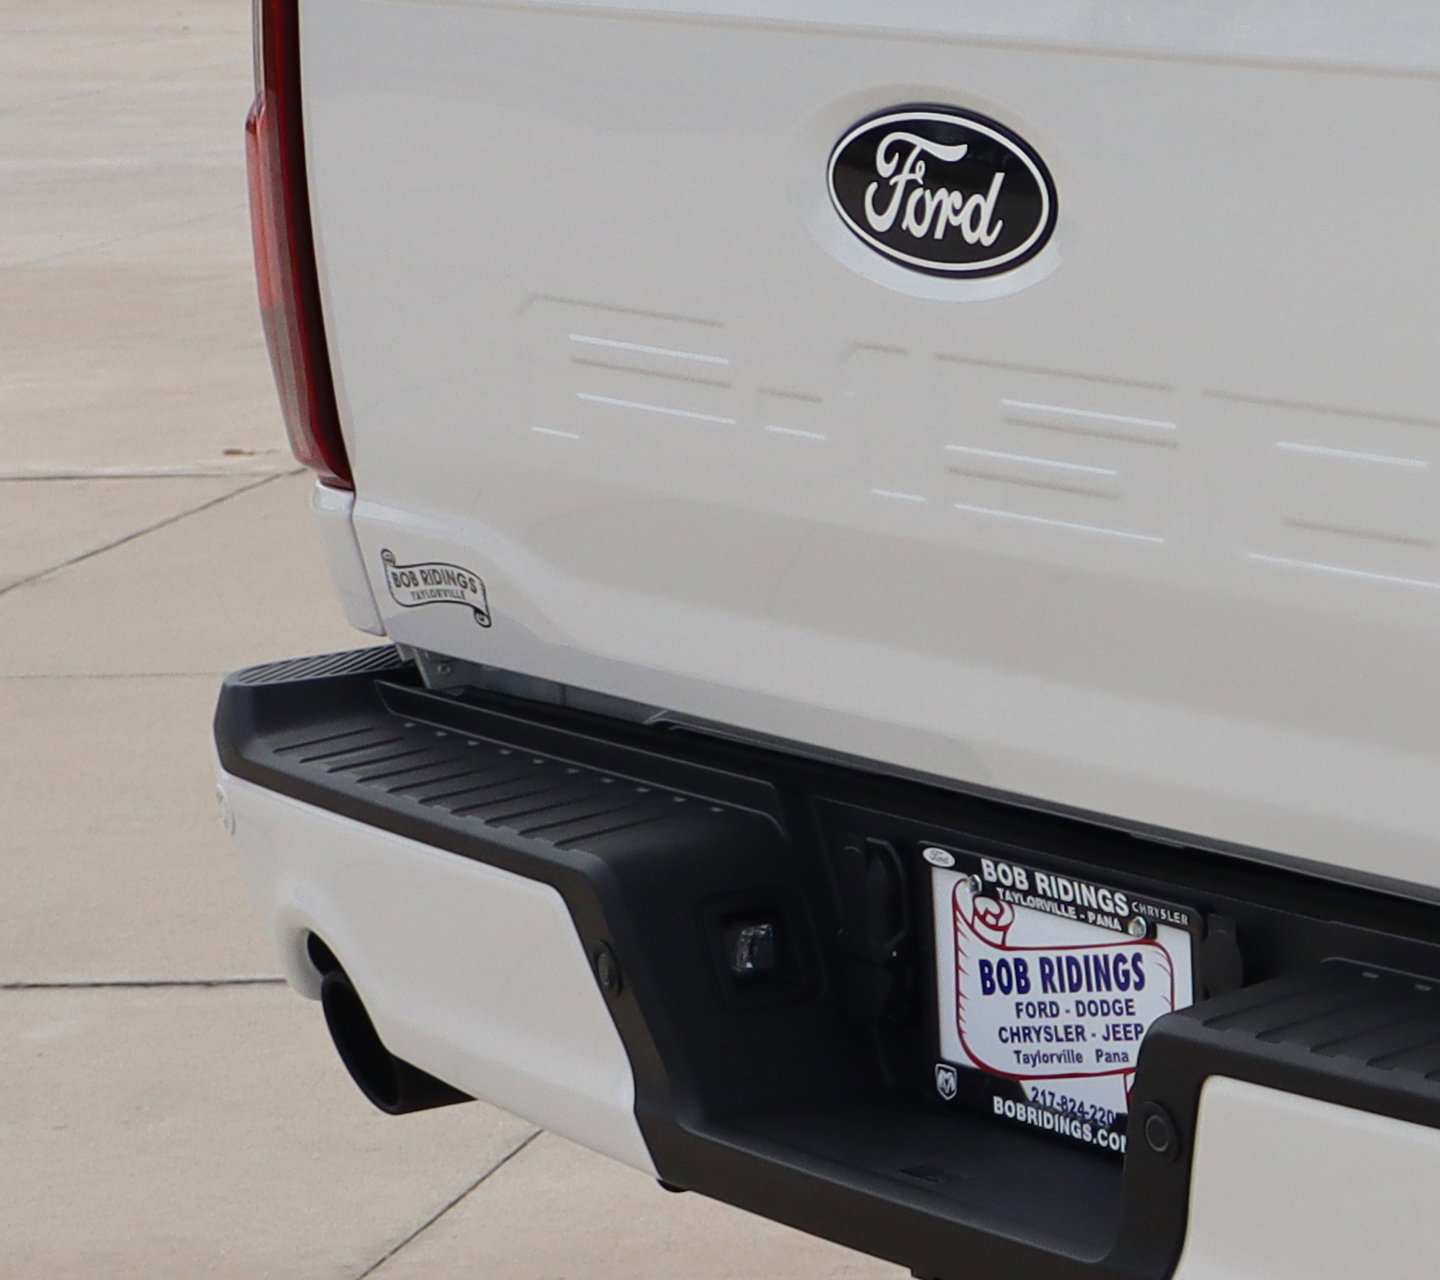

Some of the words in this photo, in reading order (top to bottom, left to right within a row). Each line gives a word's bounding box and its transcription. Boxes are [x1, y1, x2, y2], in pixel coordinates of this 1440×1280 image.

[864, 131, 1006, 247] Ford
[391, 570, 419, 588] BOB
[419, 569, 478, 594] RIDINGS
[410, 588, 467, 601] TAYLORVILLE
[981, 858, 1029, 891] BOB
[1034, 872, 1131, 918] RIDINGS
[996, 887, 1077, 920] TAYLORVILLE
[1087, 911, 1122, 932] PANA
[1131, 901, 1190, 926] CHRYSLER
[978, 957, 1032, 996] BOB
[1038, 951, 1146, 994] RIDINGS
[1014, 1001, 1060, 1019] FORD
[1075, 998, 1136, 1018] DODGE
[998, 1024, 1087, 1044] CHRYSLER
[1101, 1023, 1145, 1042] JEEP
[1013, 1049, 1084, 1068] Taylorville
[1095, 1048, 1130, 1064] Pana
[1031, 1086, 1117, 1127] 217-824-220
